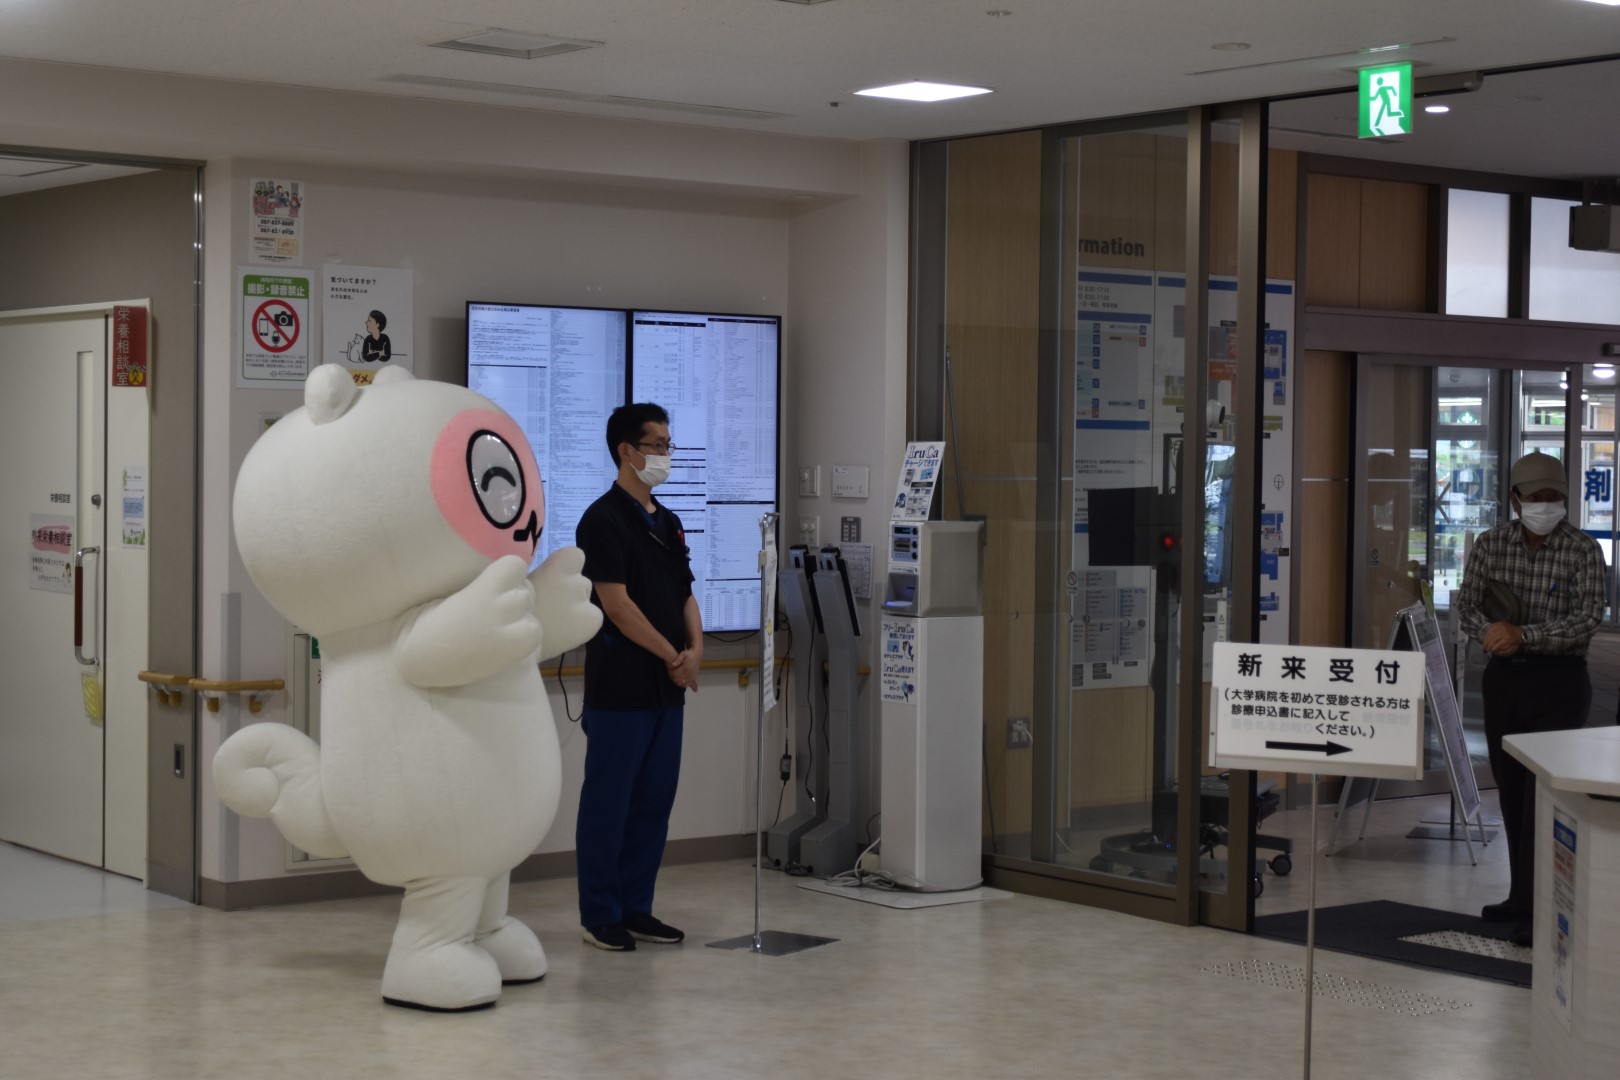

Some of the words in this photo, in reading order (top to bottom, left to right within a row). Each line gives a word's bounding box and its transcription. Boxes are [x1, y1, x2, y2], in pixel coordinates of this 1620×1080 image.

[248, 283, 305, 296] 撮影・録音禁止
[117, 306, 130, 385] 栄養相談室
[908, 445, 939, 459] IruCa
[904, 459, 939, 468] チャージできます
[1584, 468, 1611, 503] 剤
[32, 529, 72, 547] 外来栄養相談室
[1231, 704, 1350, 722] 診療申込書に記入して
